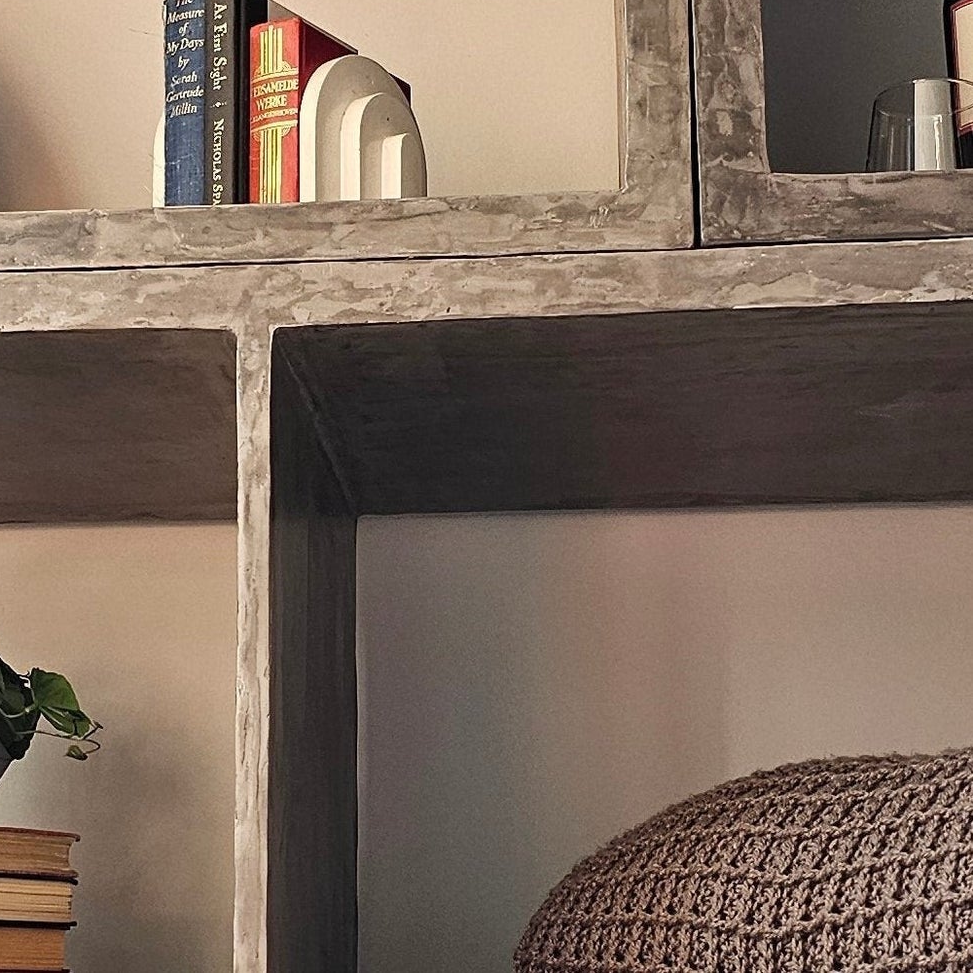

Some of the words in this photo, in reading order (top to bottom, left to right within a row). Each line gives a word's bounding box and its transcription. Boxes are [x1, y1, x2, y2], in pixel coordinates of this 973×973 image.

[166, 8, 206, 25] Measure
[213, 2, 229, 21] At
[178, 21, 190, 37] of
[213, 22, 229, 53] First
[166, 40, 180, 56] My
[179, 37, 205, 52] Days
[177, 55, 190, 71] by
[170, 70, 198, 88] Sarah
[209, 56, 229, 91] Sight
[165, 85, 205, 103] Gertrude
[169, 101, 198, 119] Millin
[212, 118, 225, 182] NICHOLAS
